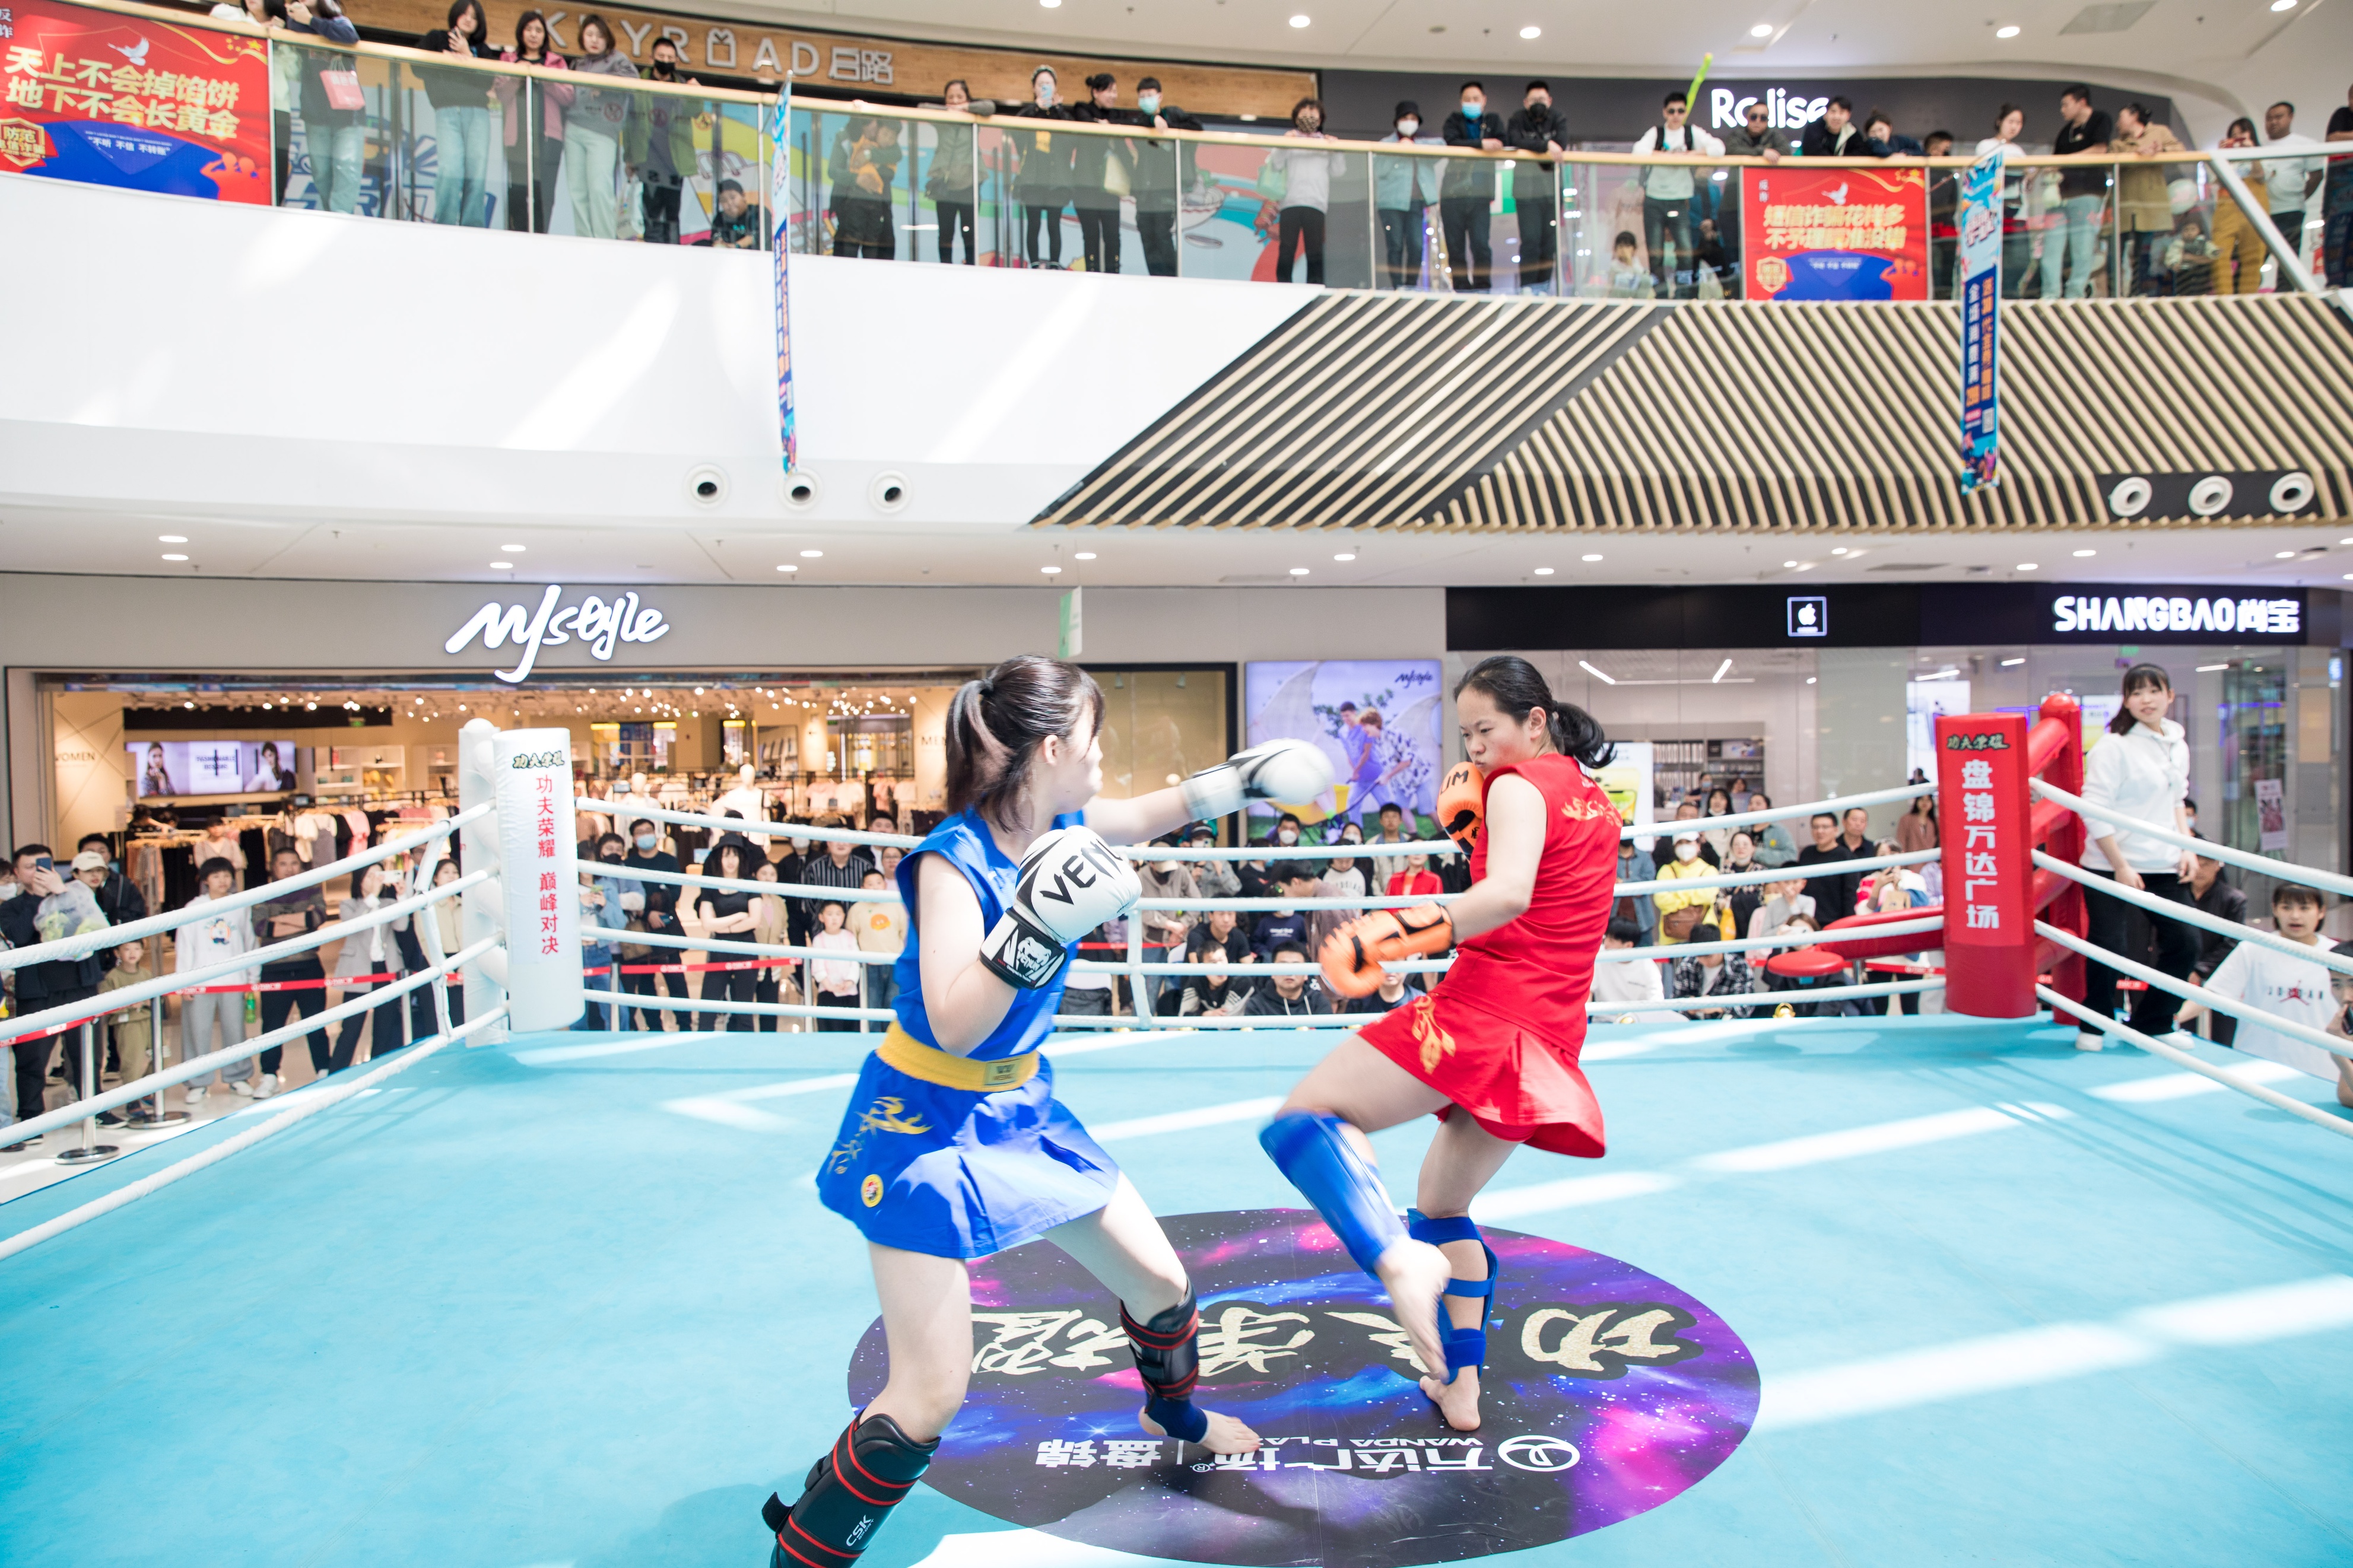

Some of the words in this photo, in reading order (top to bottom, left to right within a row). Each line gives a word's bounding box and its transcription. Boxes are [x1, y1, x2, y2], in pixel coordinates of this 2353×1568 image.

[4, 46, 239, 109] 天上不会掉馅饼
[5, 75, 240, 138] 地下不会长黄金
[4, 126, 36, 144] 防范
[2053, 596, 2235, 632] SHANGBAO
[536, 774, 555, 858] 功夫荣耀
[1961, 759, 1999, 929] 盘锦万达广场
[539, 872, 559, 955] 巅峰对决
[1036, 1439, 1163, 1468] 盘锦
[1258, 1436, 1339, 1447] PLA
[1349, 1437, 1484, 1448] WANDA
[846, 1515, 872, 1547] CSK
